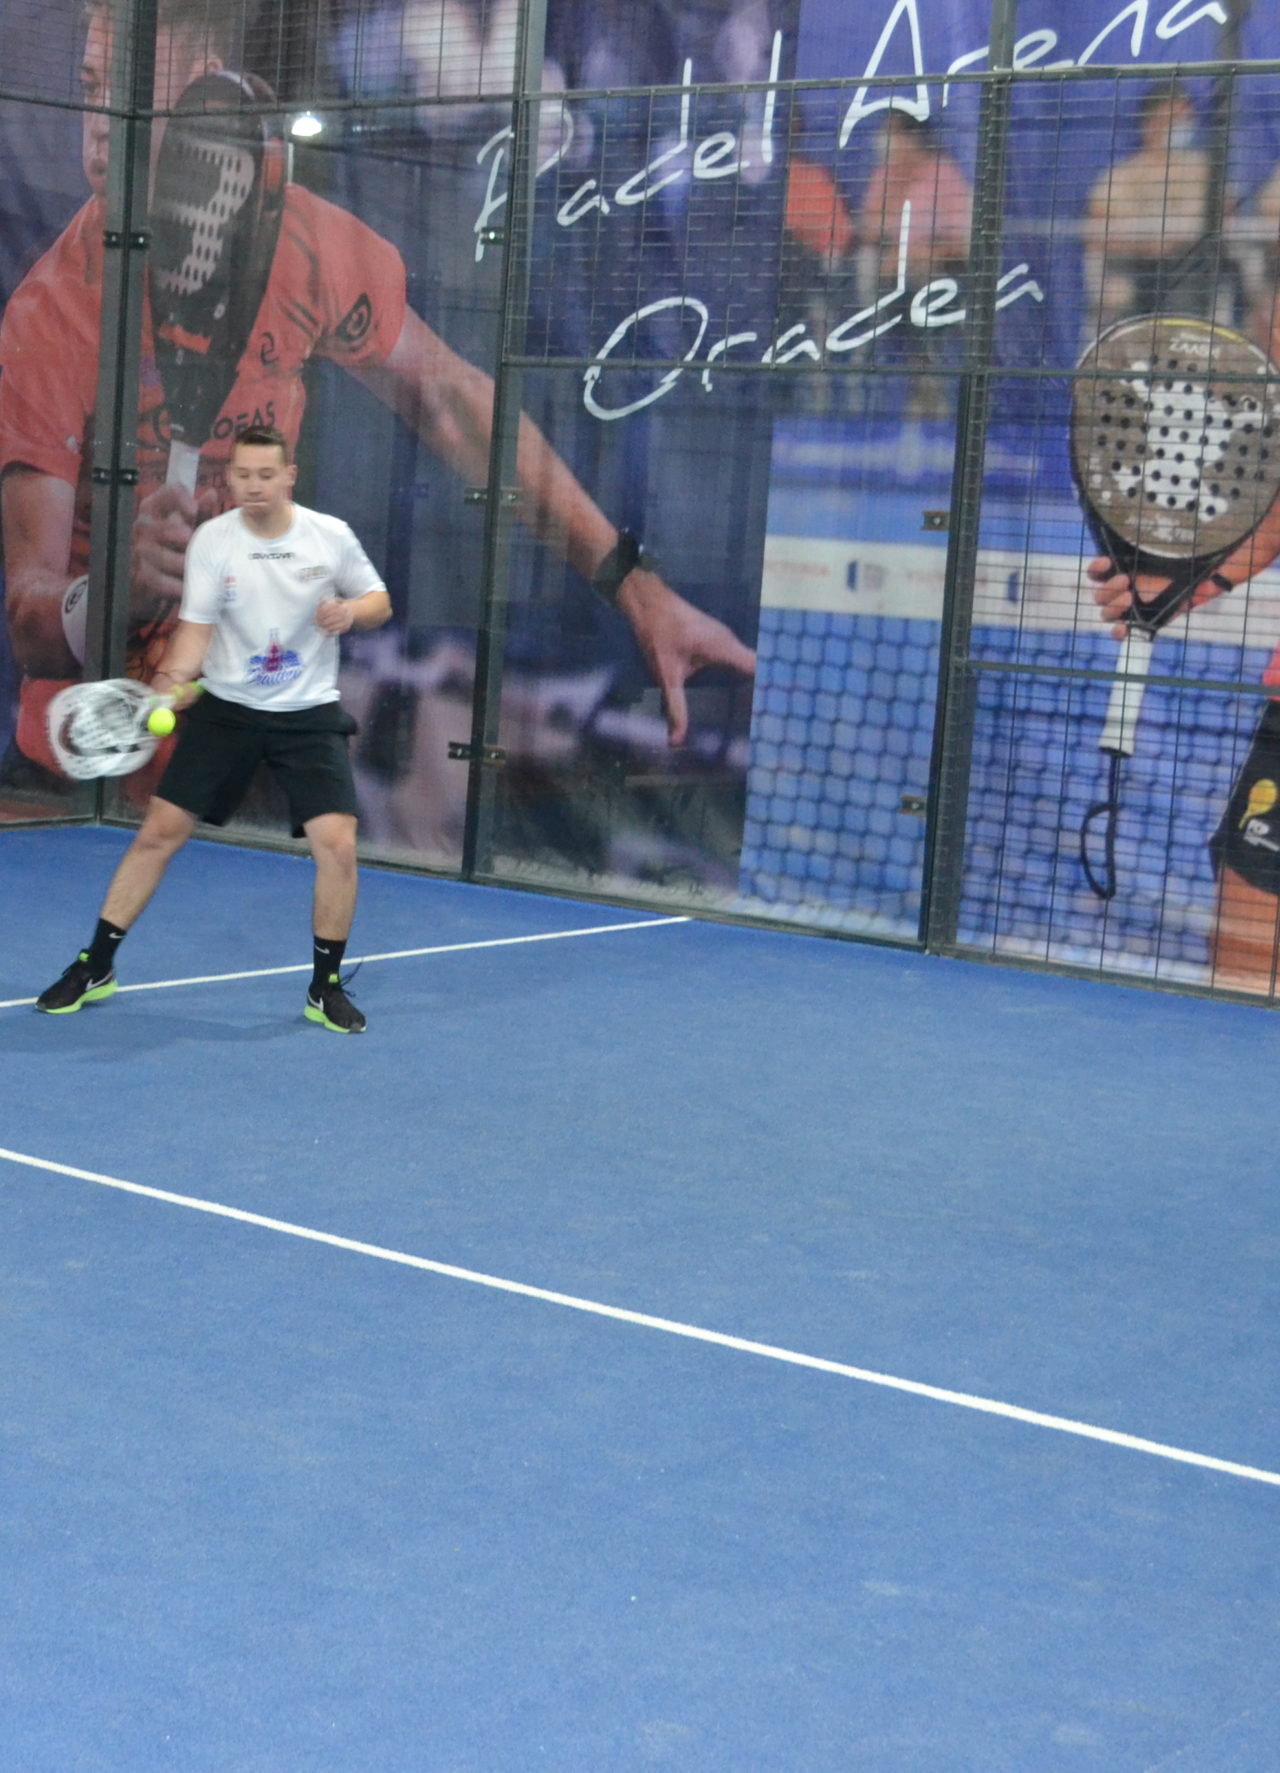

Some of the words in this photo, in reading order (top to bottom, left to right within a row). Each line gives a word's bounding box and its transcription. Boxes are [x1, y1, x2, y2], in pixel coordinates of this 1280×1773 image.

[475, 30, 782, 262] Padel
[838, 0, 1228, 150] Arena
[583, 200, 1045, 421] Oradea
